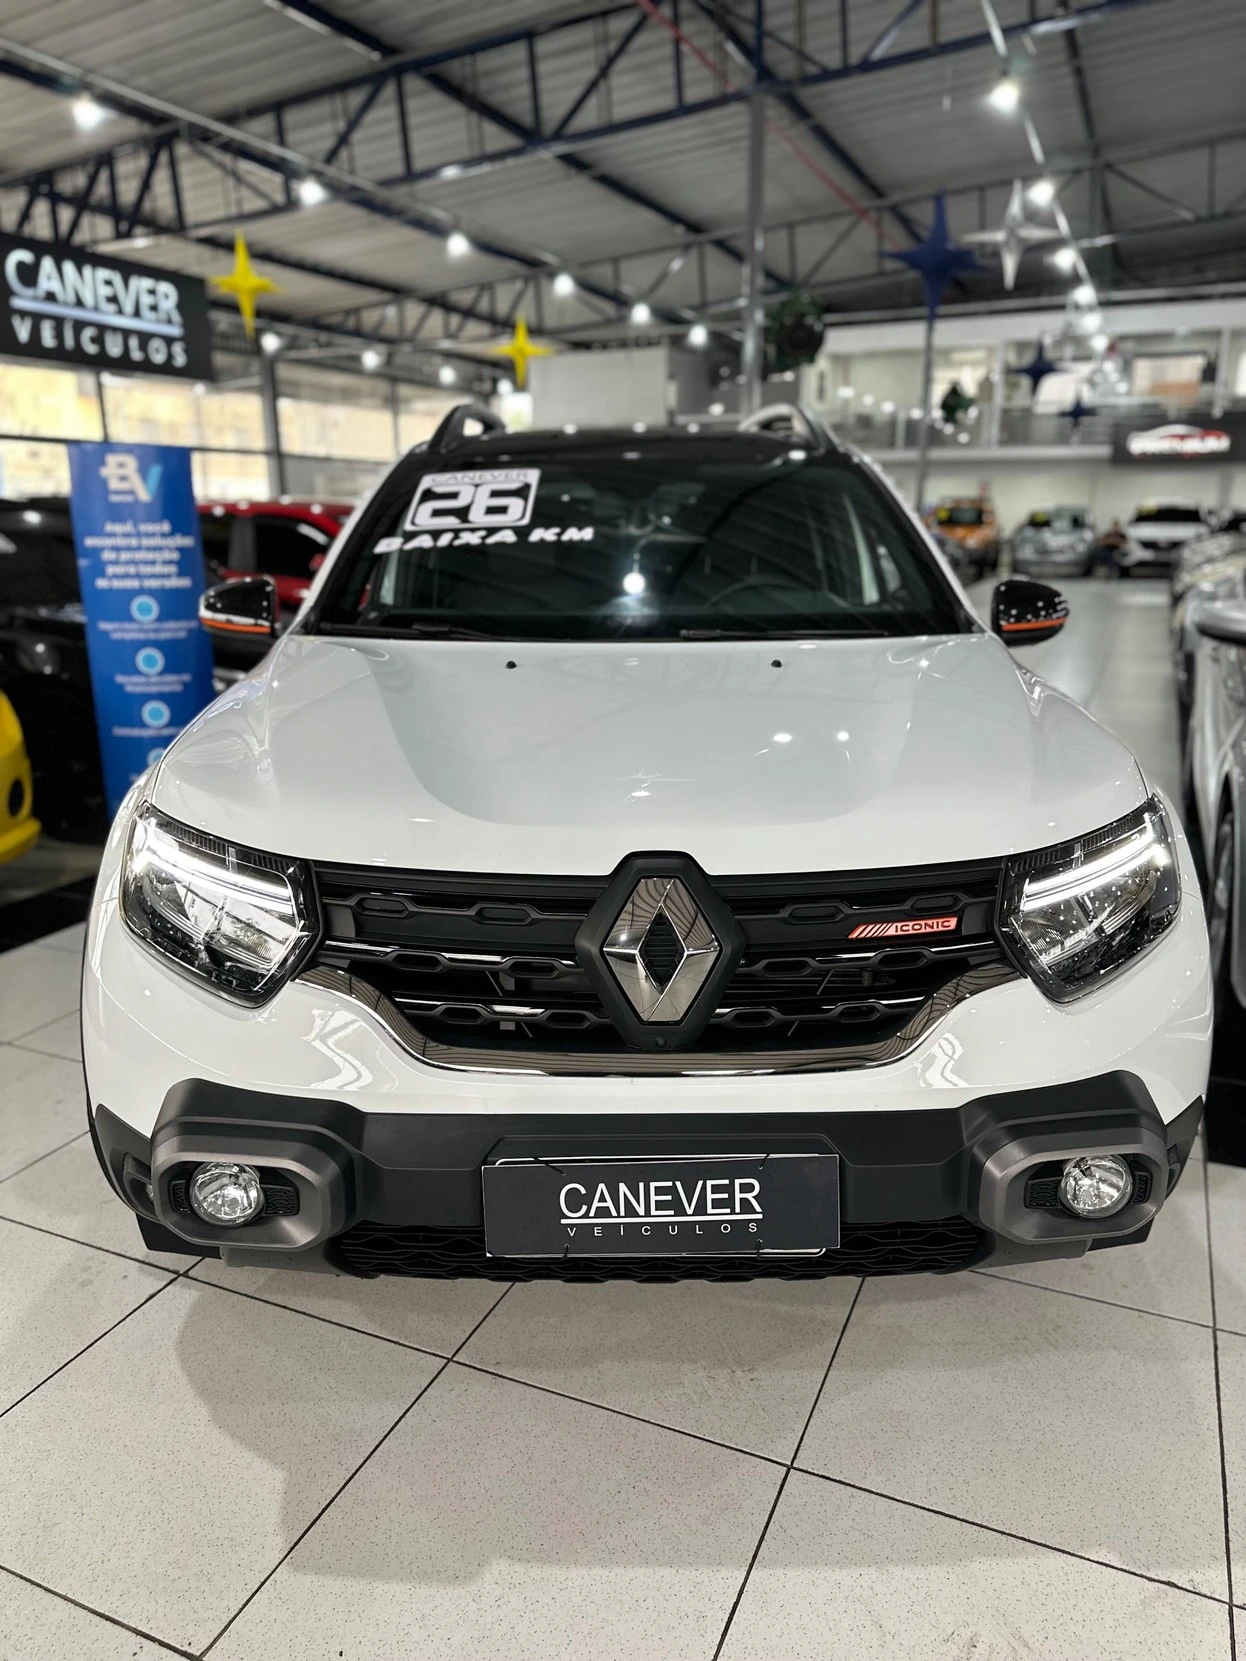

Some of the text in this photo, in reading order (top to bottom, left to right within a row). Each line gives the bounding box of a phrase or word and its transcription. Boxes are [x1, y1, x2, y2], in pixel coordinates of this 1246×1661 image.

[5, 248, 183, 326] CANEVER
[11, 314, 188, 368] VEÍCULOS
[431, 470, 528, 484] CANEVER
[413, 482, 526, 526] 26
[373, 527, 595, 554] BAIXA KM
[894, 920, 951, 933] ICONIC
[558, 1177, 763, 1218] CANEVER
[567, 1222, 758, 1237] VEÍCULOS
